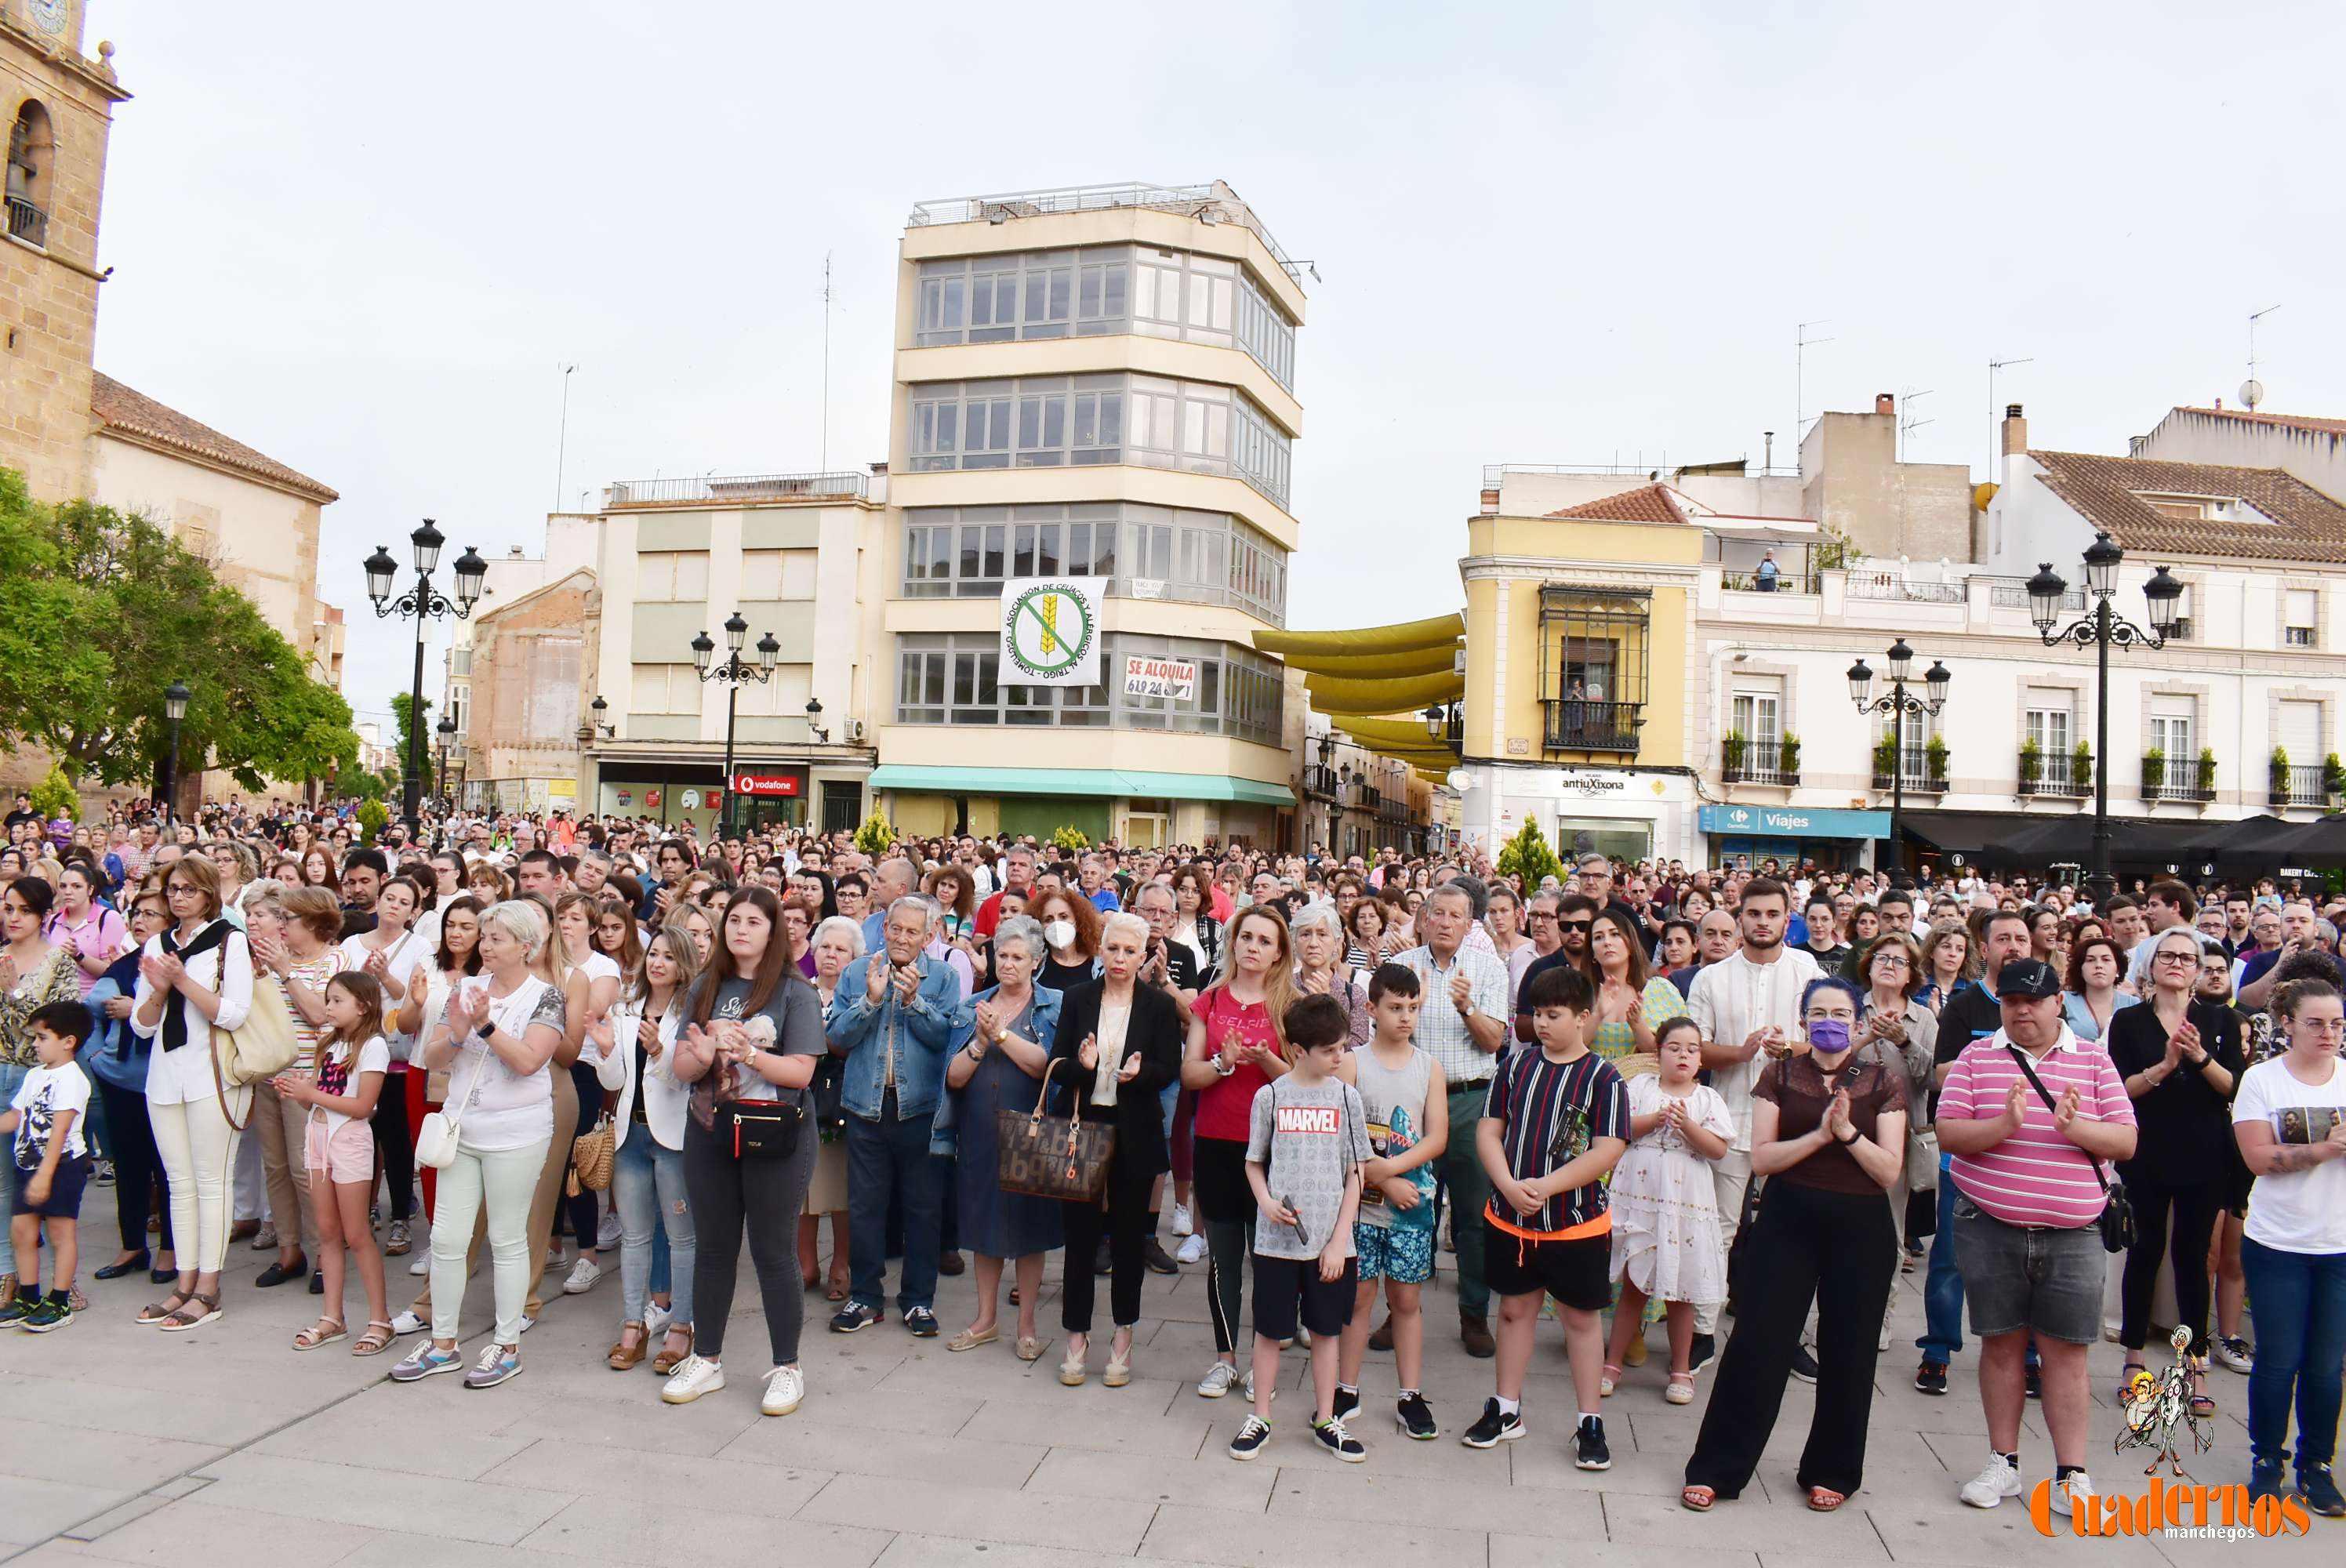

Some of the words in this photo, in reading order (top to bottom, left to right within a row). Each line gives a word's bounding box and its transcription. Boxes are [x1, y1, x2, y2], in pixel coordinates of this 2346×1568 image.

[1055, 583, 1088, 604] CELÍACOS
[1006, 586, 1040, 628] ASOCIACIÓN
[1077, 613, 1095, 661] ALÉRGICOS
[1005, 636, 1036, 677] TOMELLOSO
[1069, 660, 1078, 670] AL
[1043, 668, 1070, 679] TRIGO
[1128, 660, 1142, 675] SE
[1145, 662, 1193, 681] ALQUILA
[1148, 681, 1162, 695] 24
[754, 781, 791, 790] vodafone
[1766, 814, 1809, 830] Viajes
[2280, 868, 2303, 877] BAKERY
[1278, 1108, 1337, 1133] MARVEL
